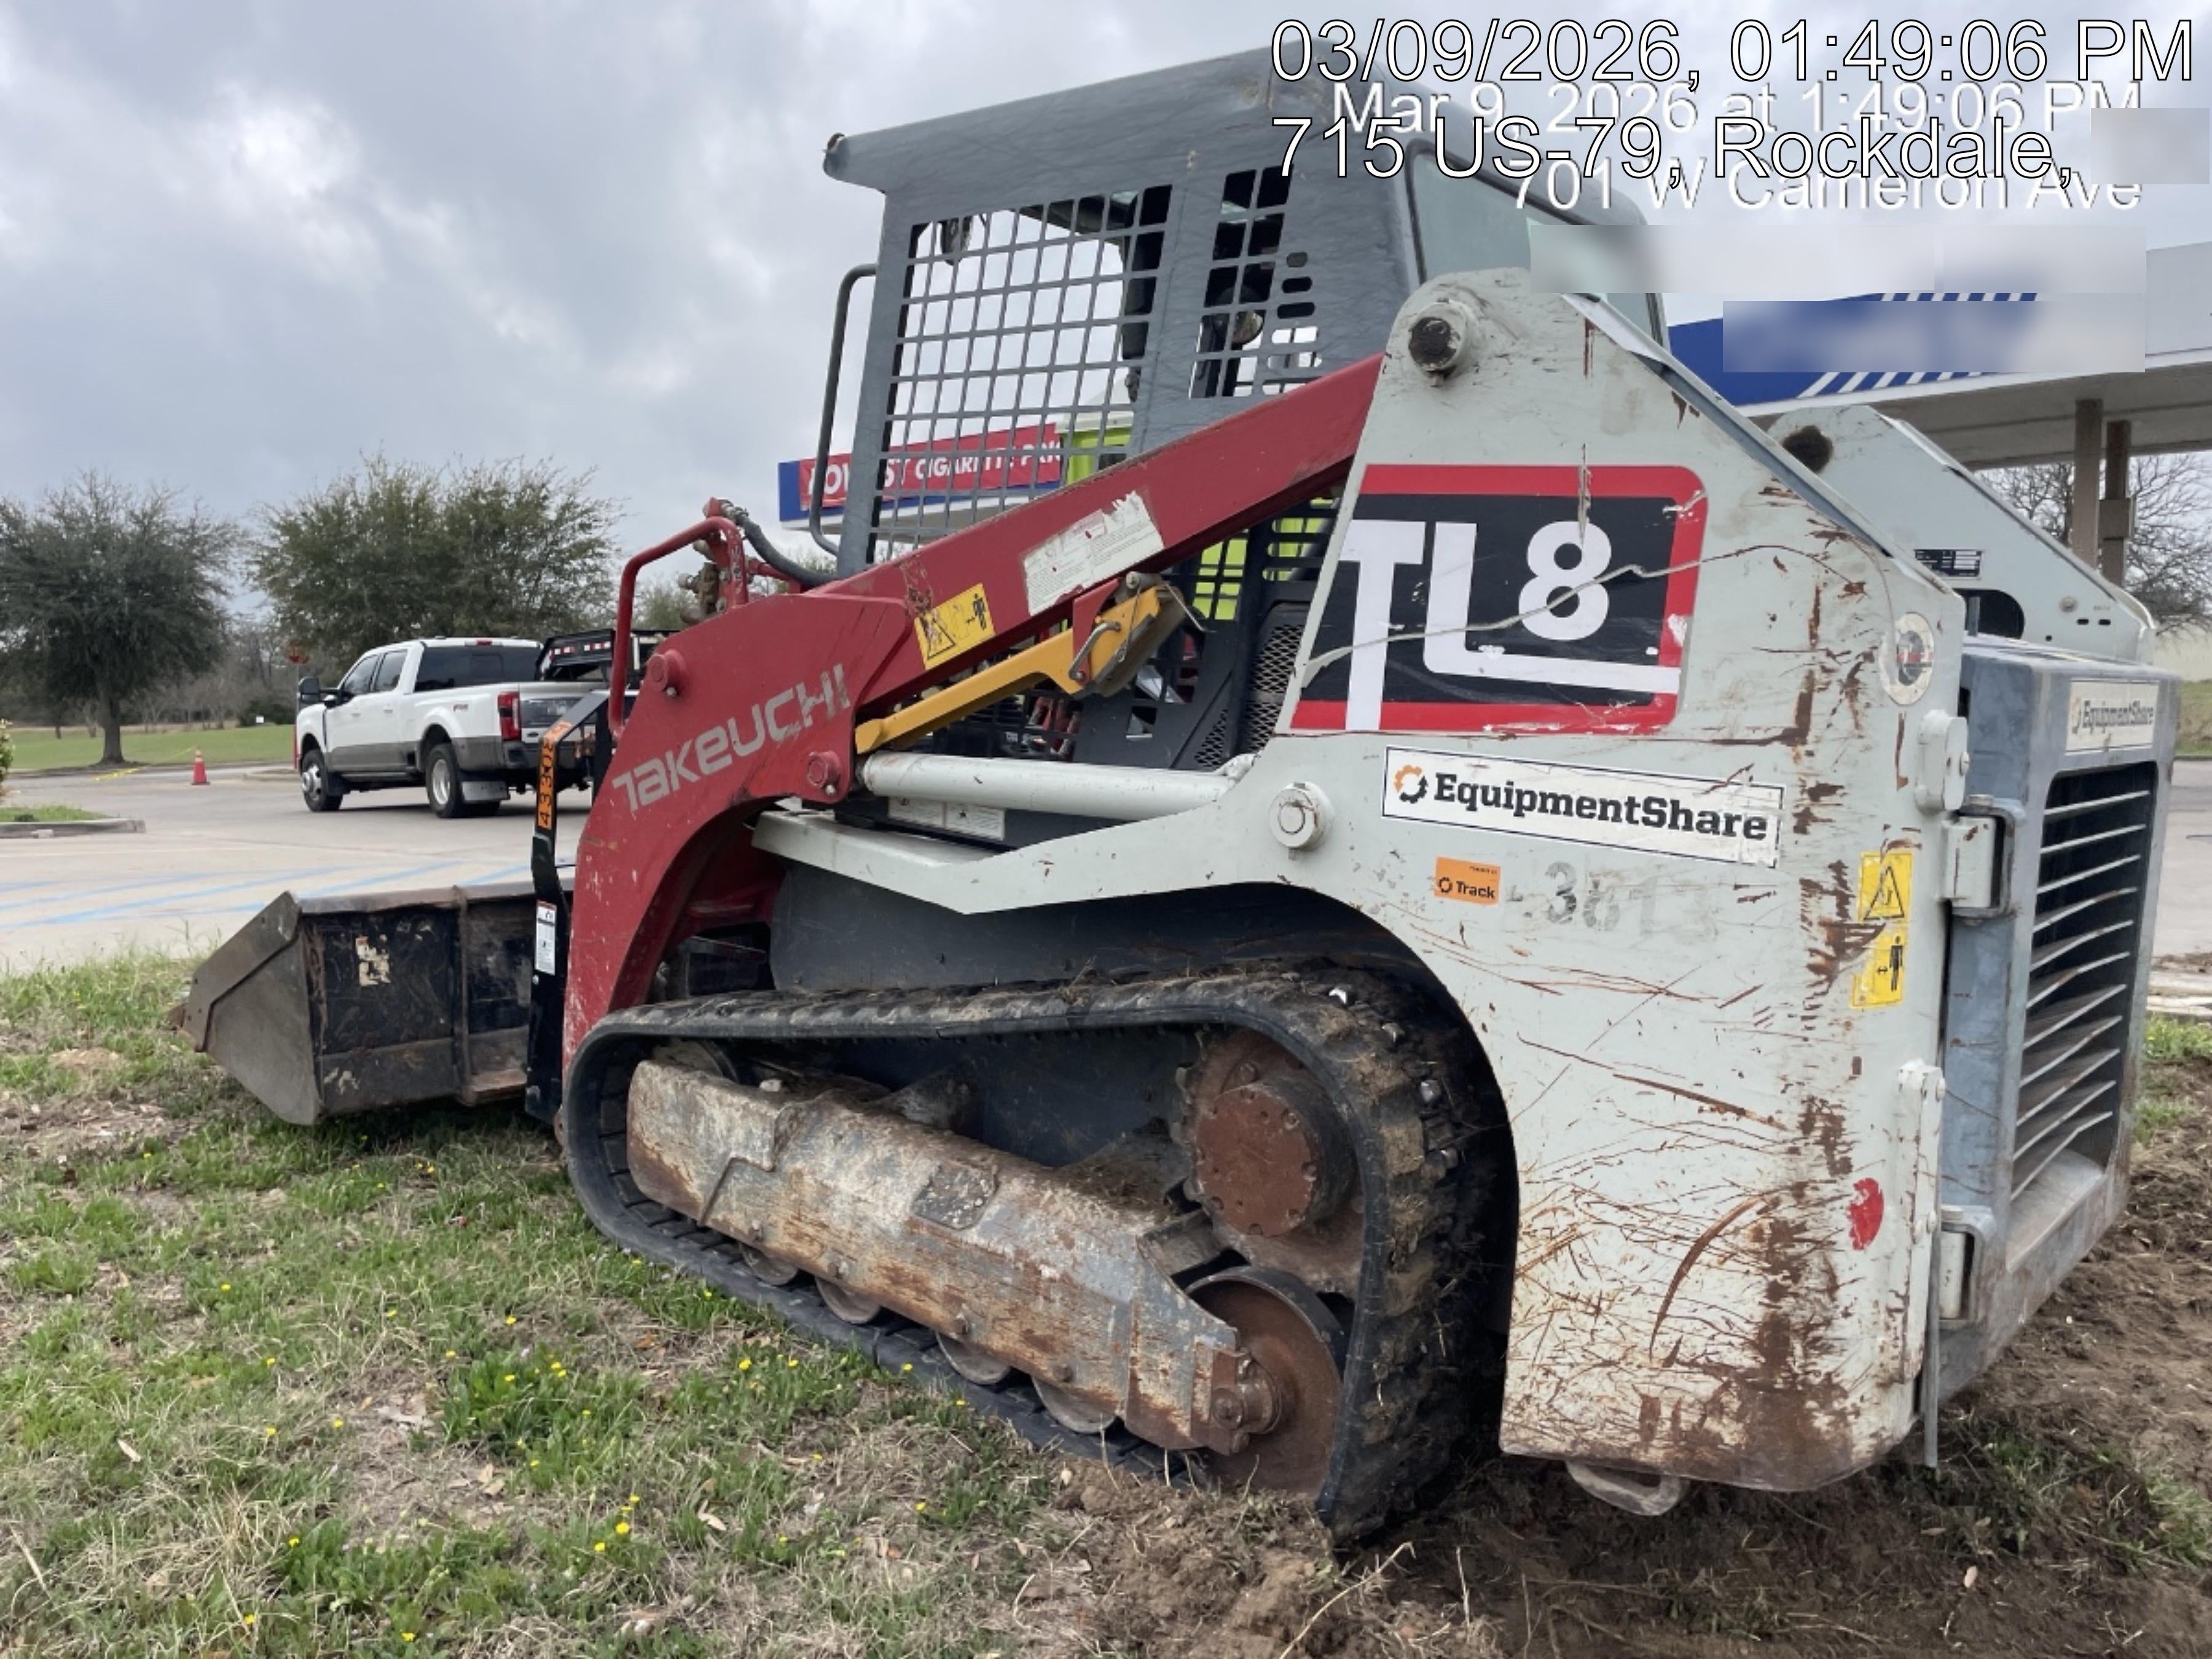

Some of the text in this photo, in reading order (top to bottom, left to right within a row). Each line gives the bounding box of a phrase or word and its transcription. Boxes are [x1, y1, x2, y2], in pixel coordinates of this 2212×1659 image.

[1338, 519, 1681, 730] TL8
[612, 663, 850, 812] TAKEUCHI
[1434, 772, 1768, 840] EquipmentShare
[1456, 880, 1496, 899] Track
